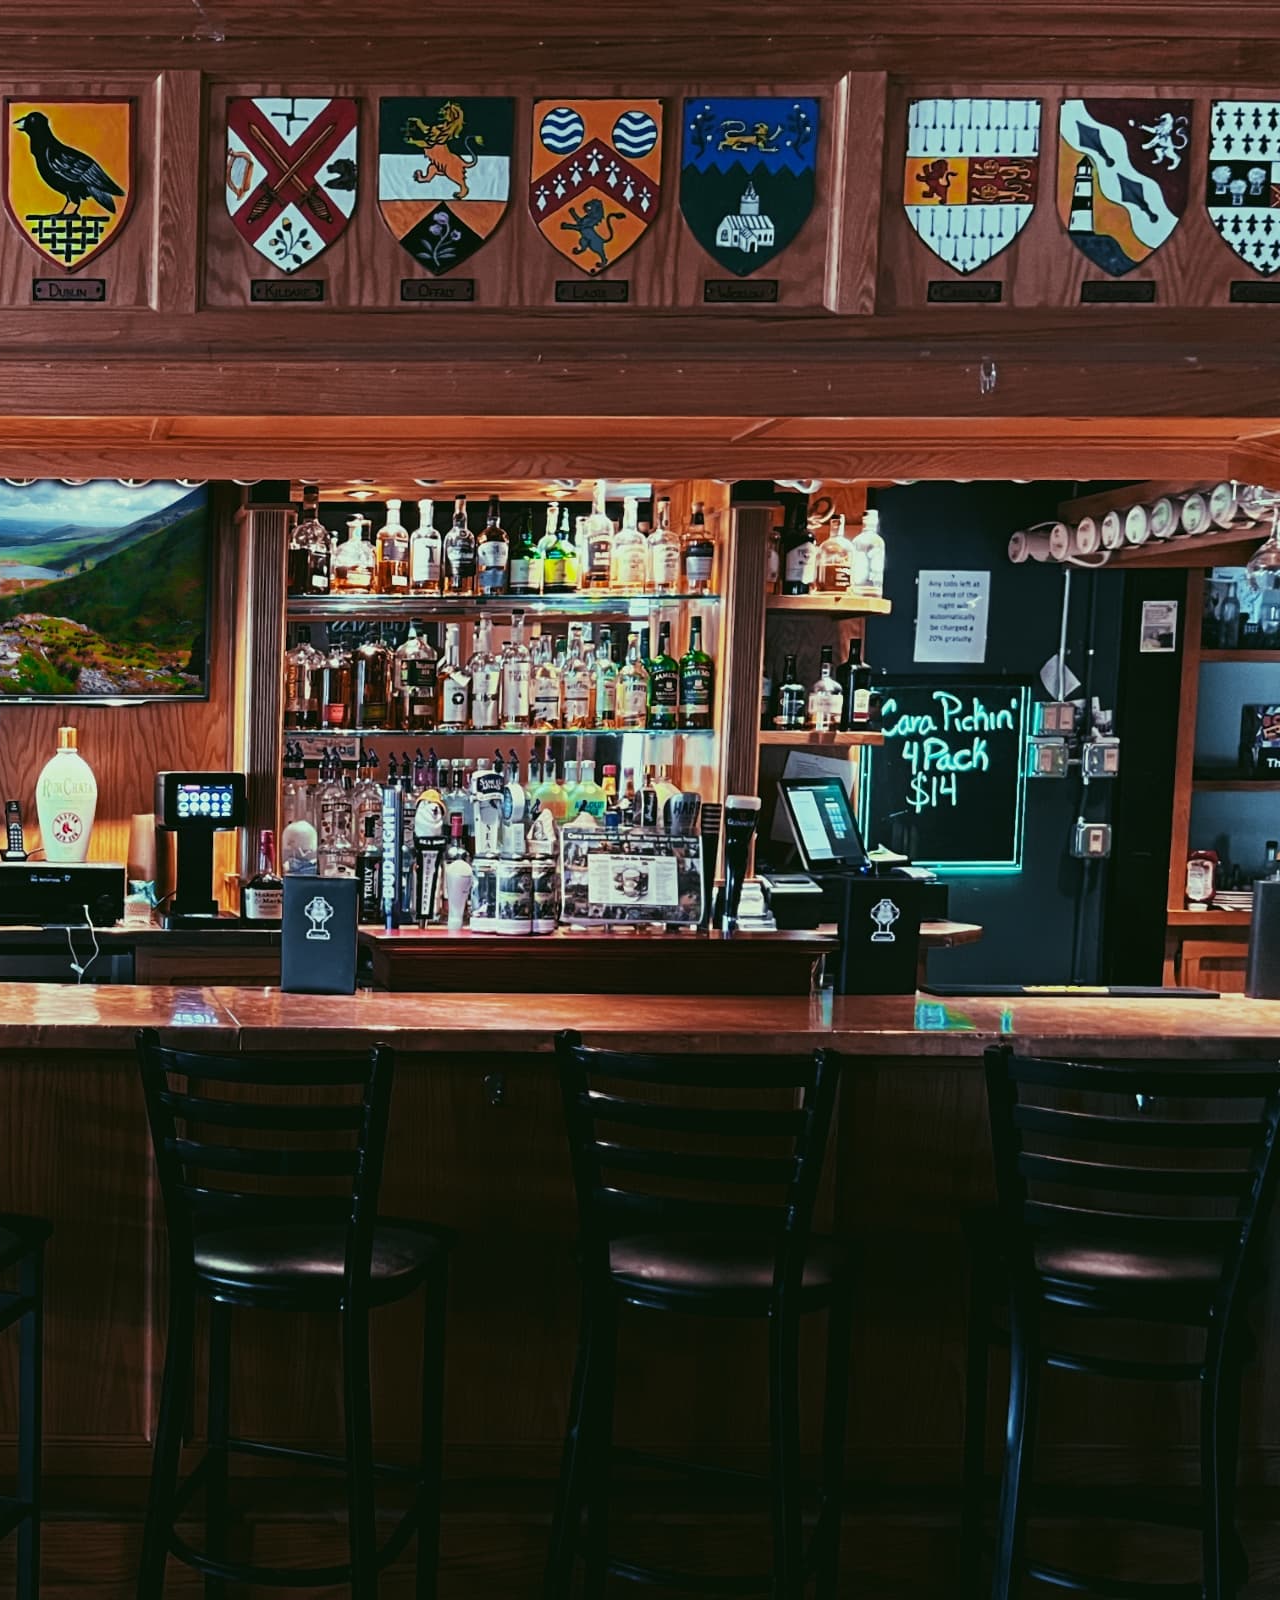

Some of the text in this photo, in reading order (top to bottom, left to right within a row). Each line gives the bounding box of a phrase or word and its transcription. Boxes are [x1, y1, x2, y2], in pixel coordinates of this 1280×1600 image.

[48, 283, 87, 298] DUBLIN
[683, 669, 711, 680] JAMESO
[882, 691, 1018, 737] Cara Pickin'
[902, 737, 990, 775] 4 Pack
[906, 771, 958, 814] $14
[382, 805, 395, 899] BUD LIGHT
[363, 866, 374, 899] TRULY
